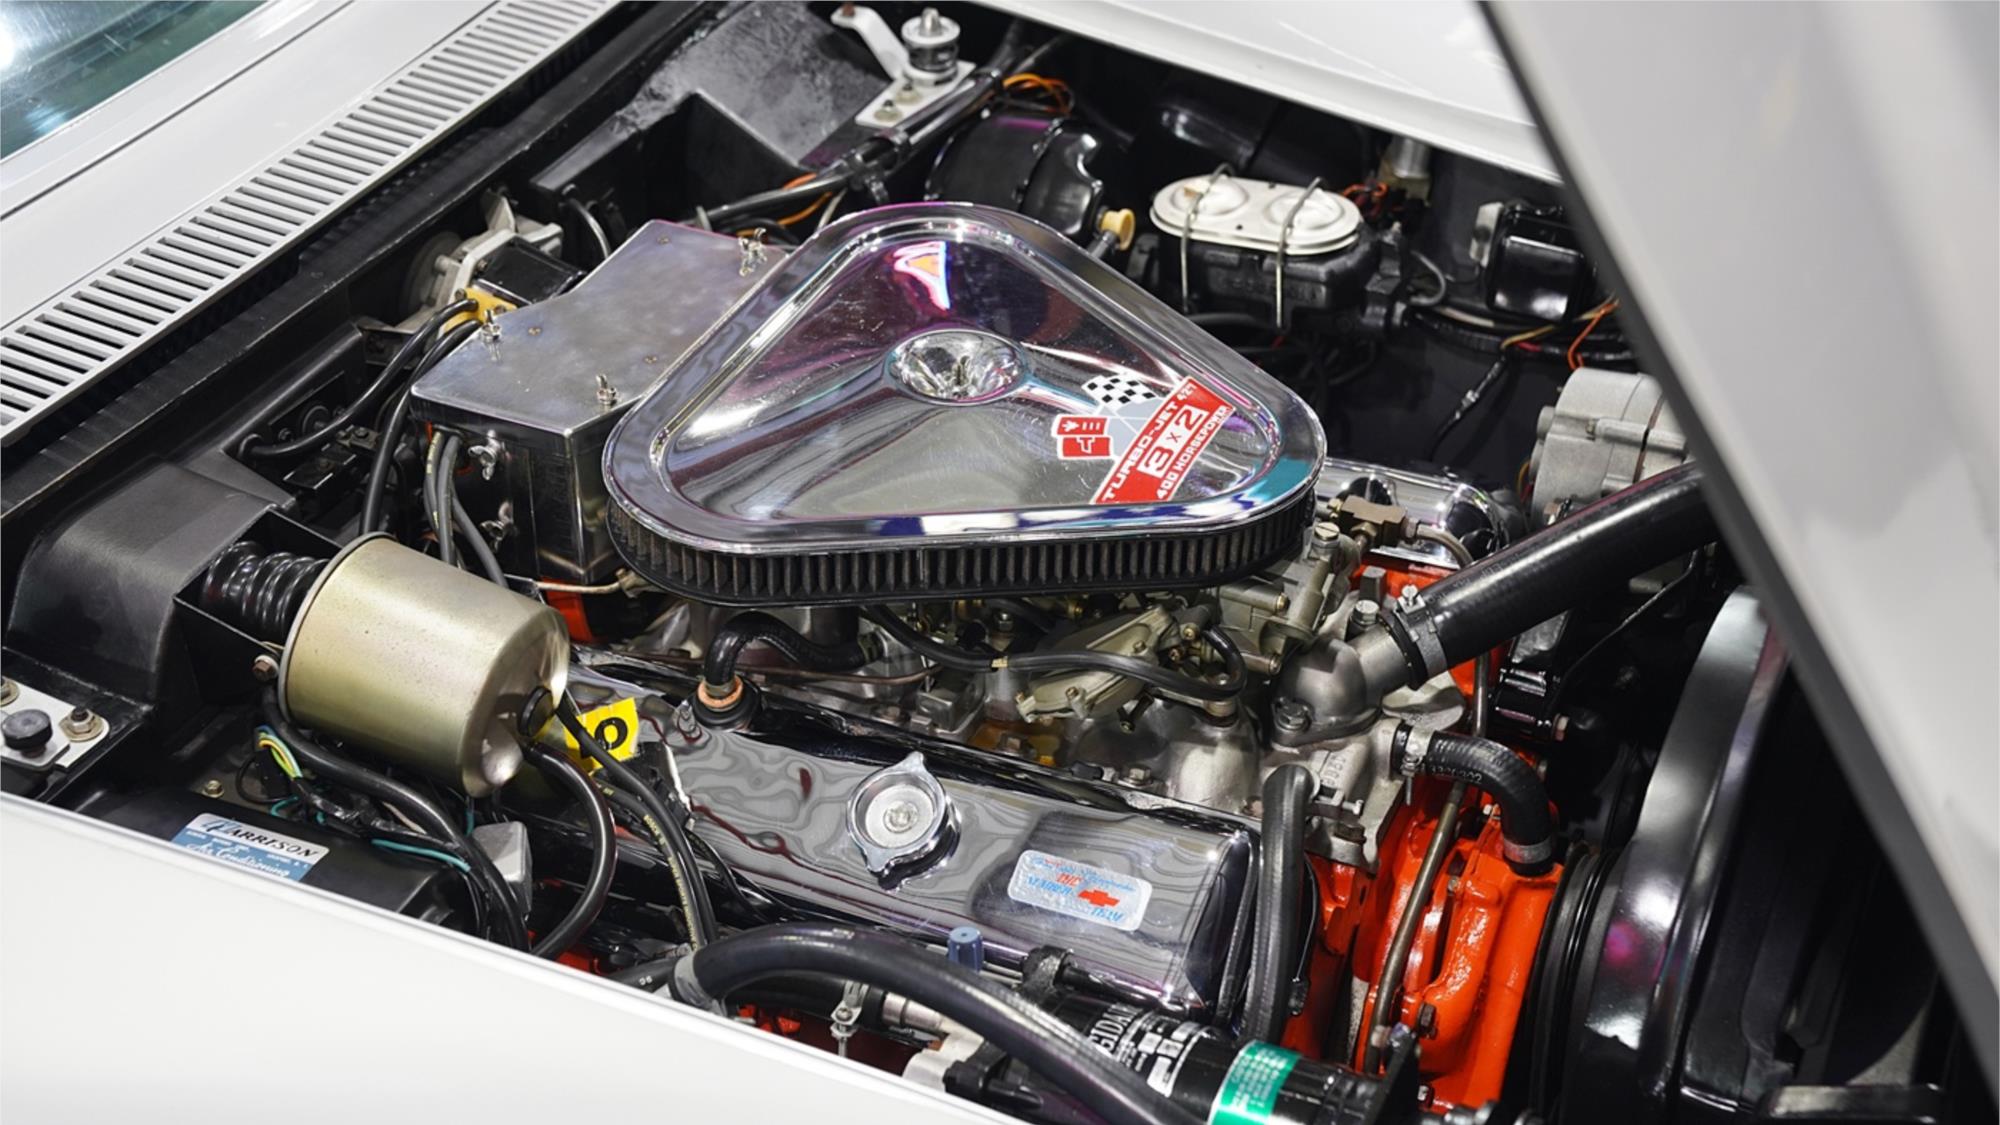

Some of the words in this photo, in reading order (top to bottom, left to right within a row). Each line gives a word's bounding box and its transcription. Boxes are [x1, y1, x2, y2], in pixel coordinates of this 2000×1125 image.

[1102, 401, 1179, 501] TURBO-JET
[1176, 383, 1197, 401] 427
[1143, 446, 1174, 471] 3
[1174, 409, 1203, 431] 2
[1156, 471, 1180, 499] 400
[1175, 405, 1229, 472] HORSEPOWER
[202, 818, 319, 857] HARRISON
